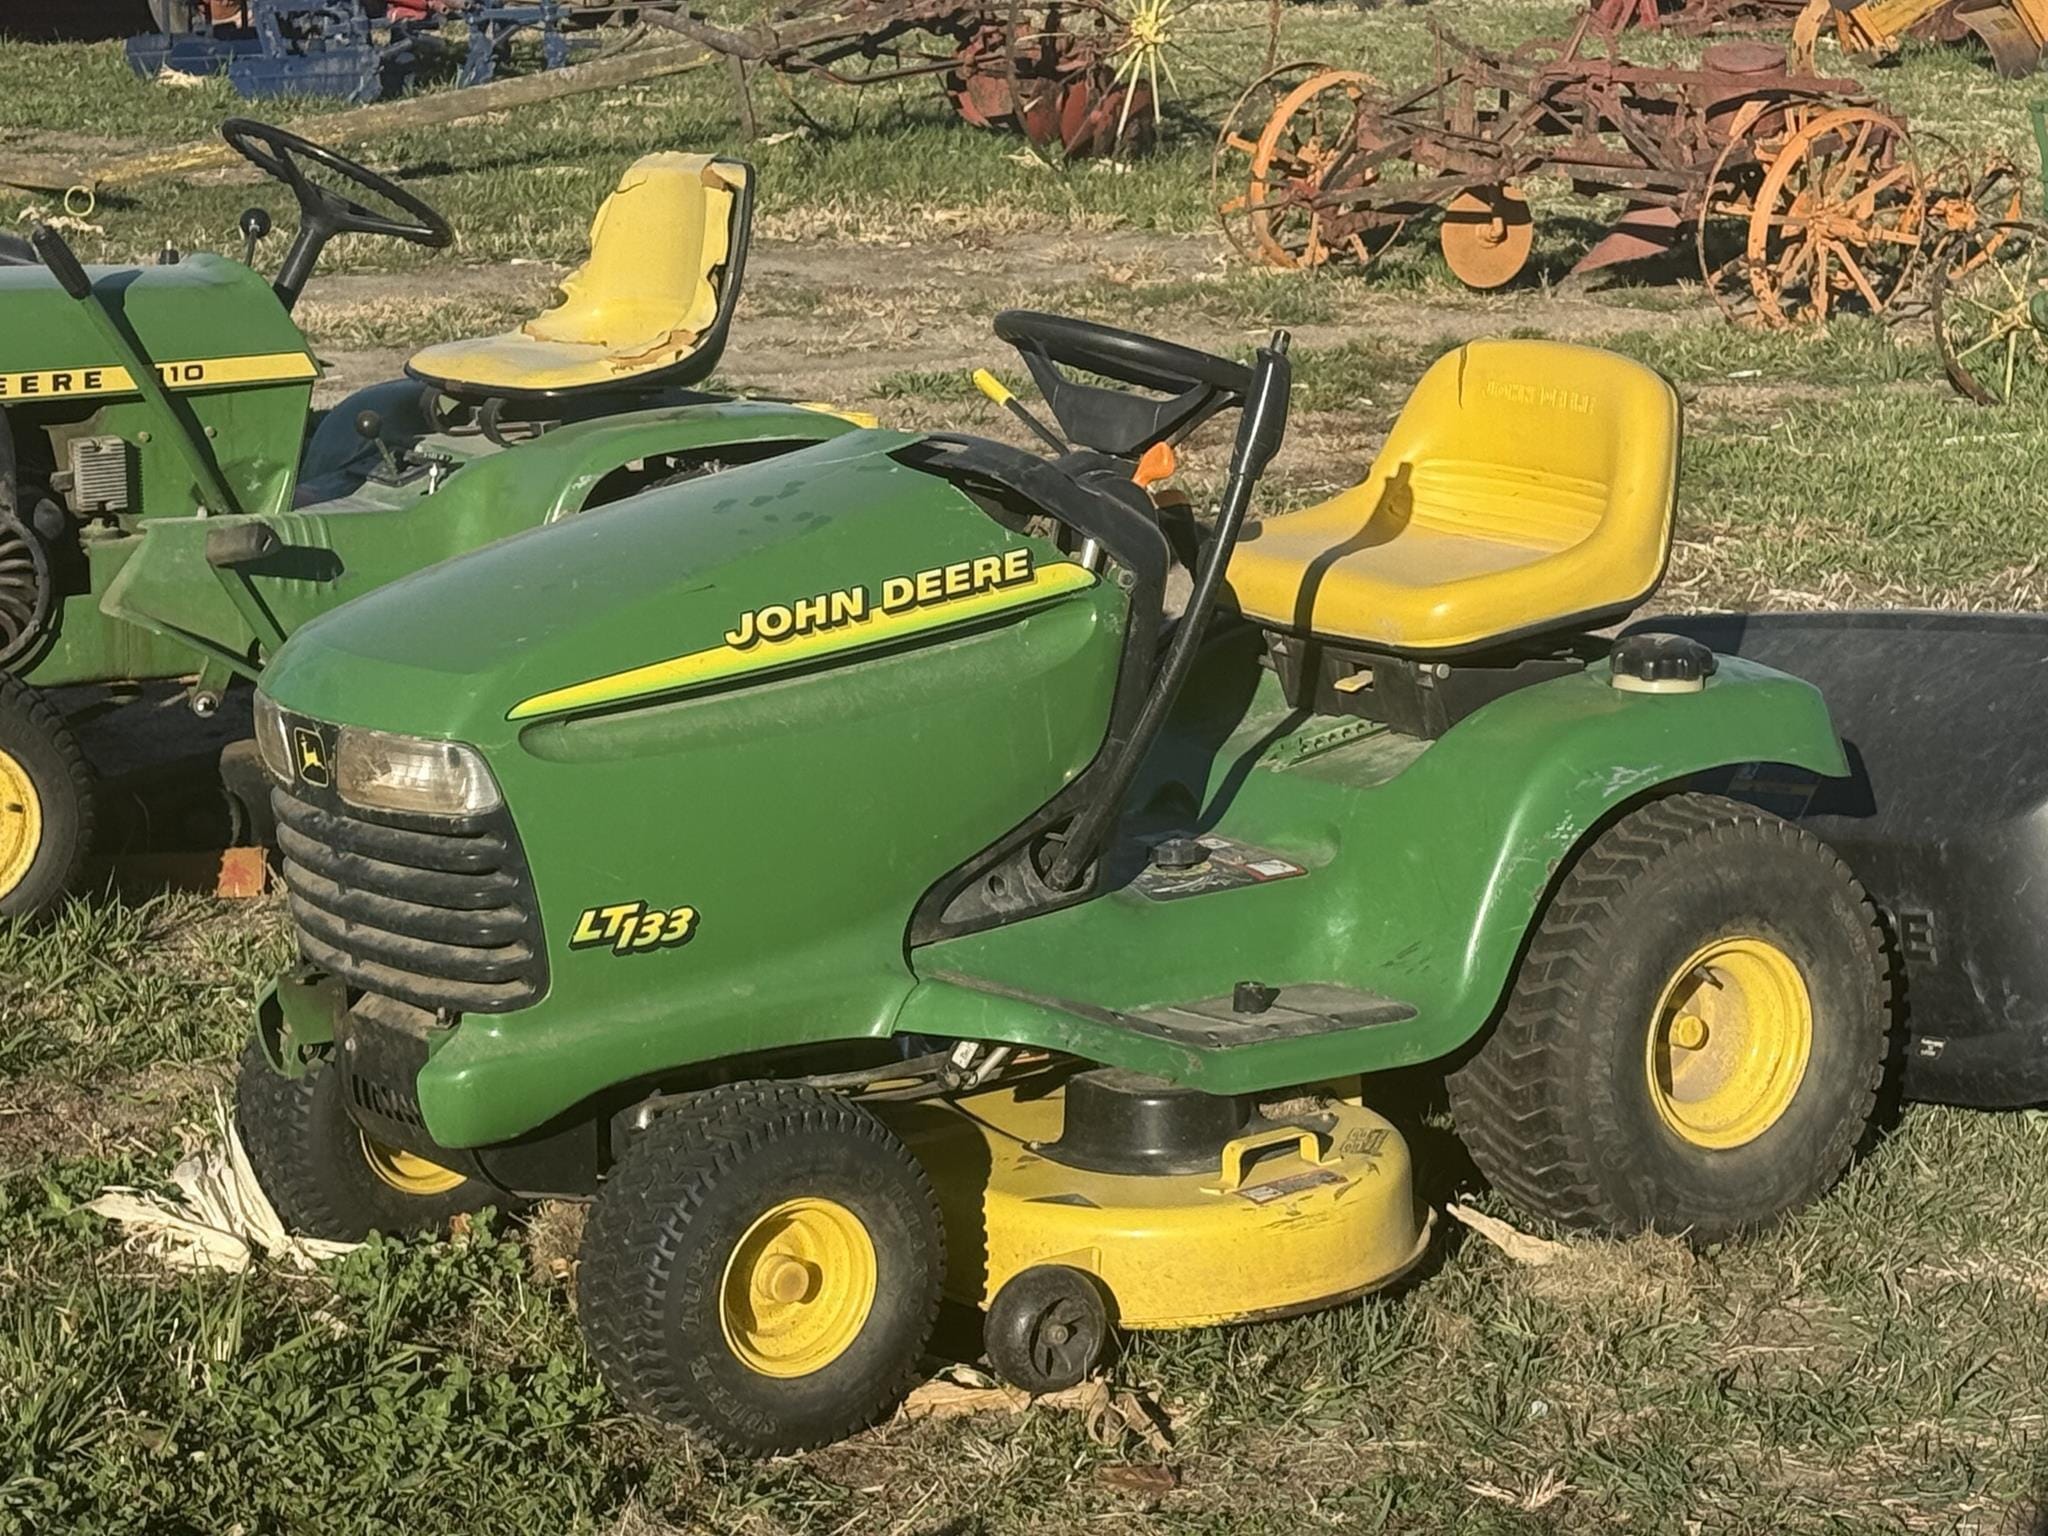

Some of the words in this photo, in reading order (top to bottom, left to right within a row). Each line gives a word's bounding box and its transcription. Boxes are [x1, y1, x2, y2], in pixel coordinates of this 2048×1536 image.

[724, 587, 867, 649] JOHN
[882, 548, 1034, 614] DEERE
[570, 901, 697, 955] LT133
